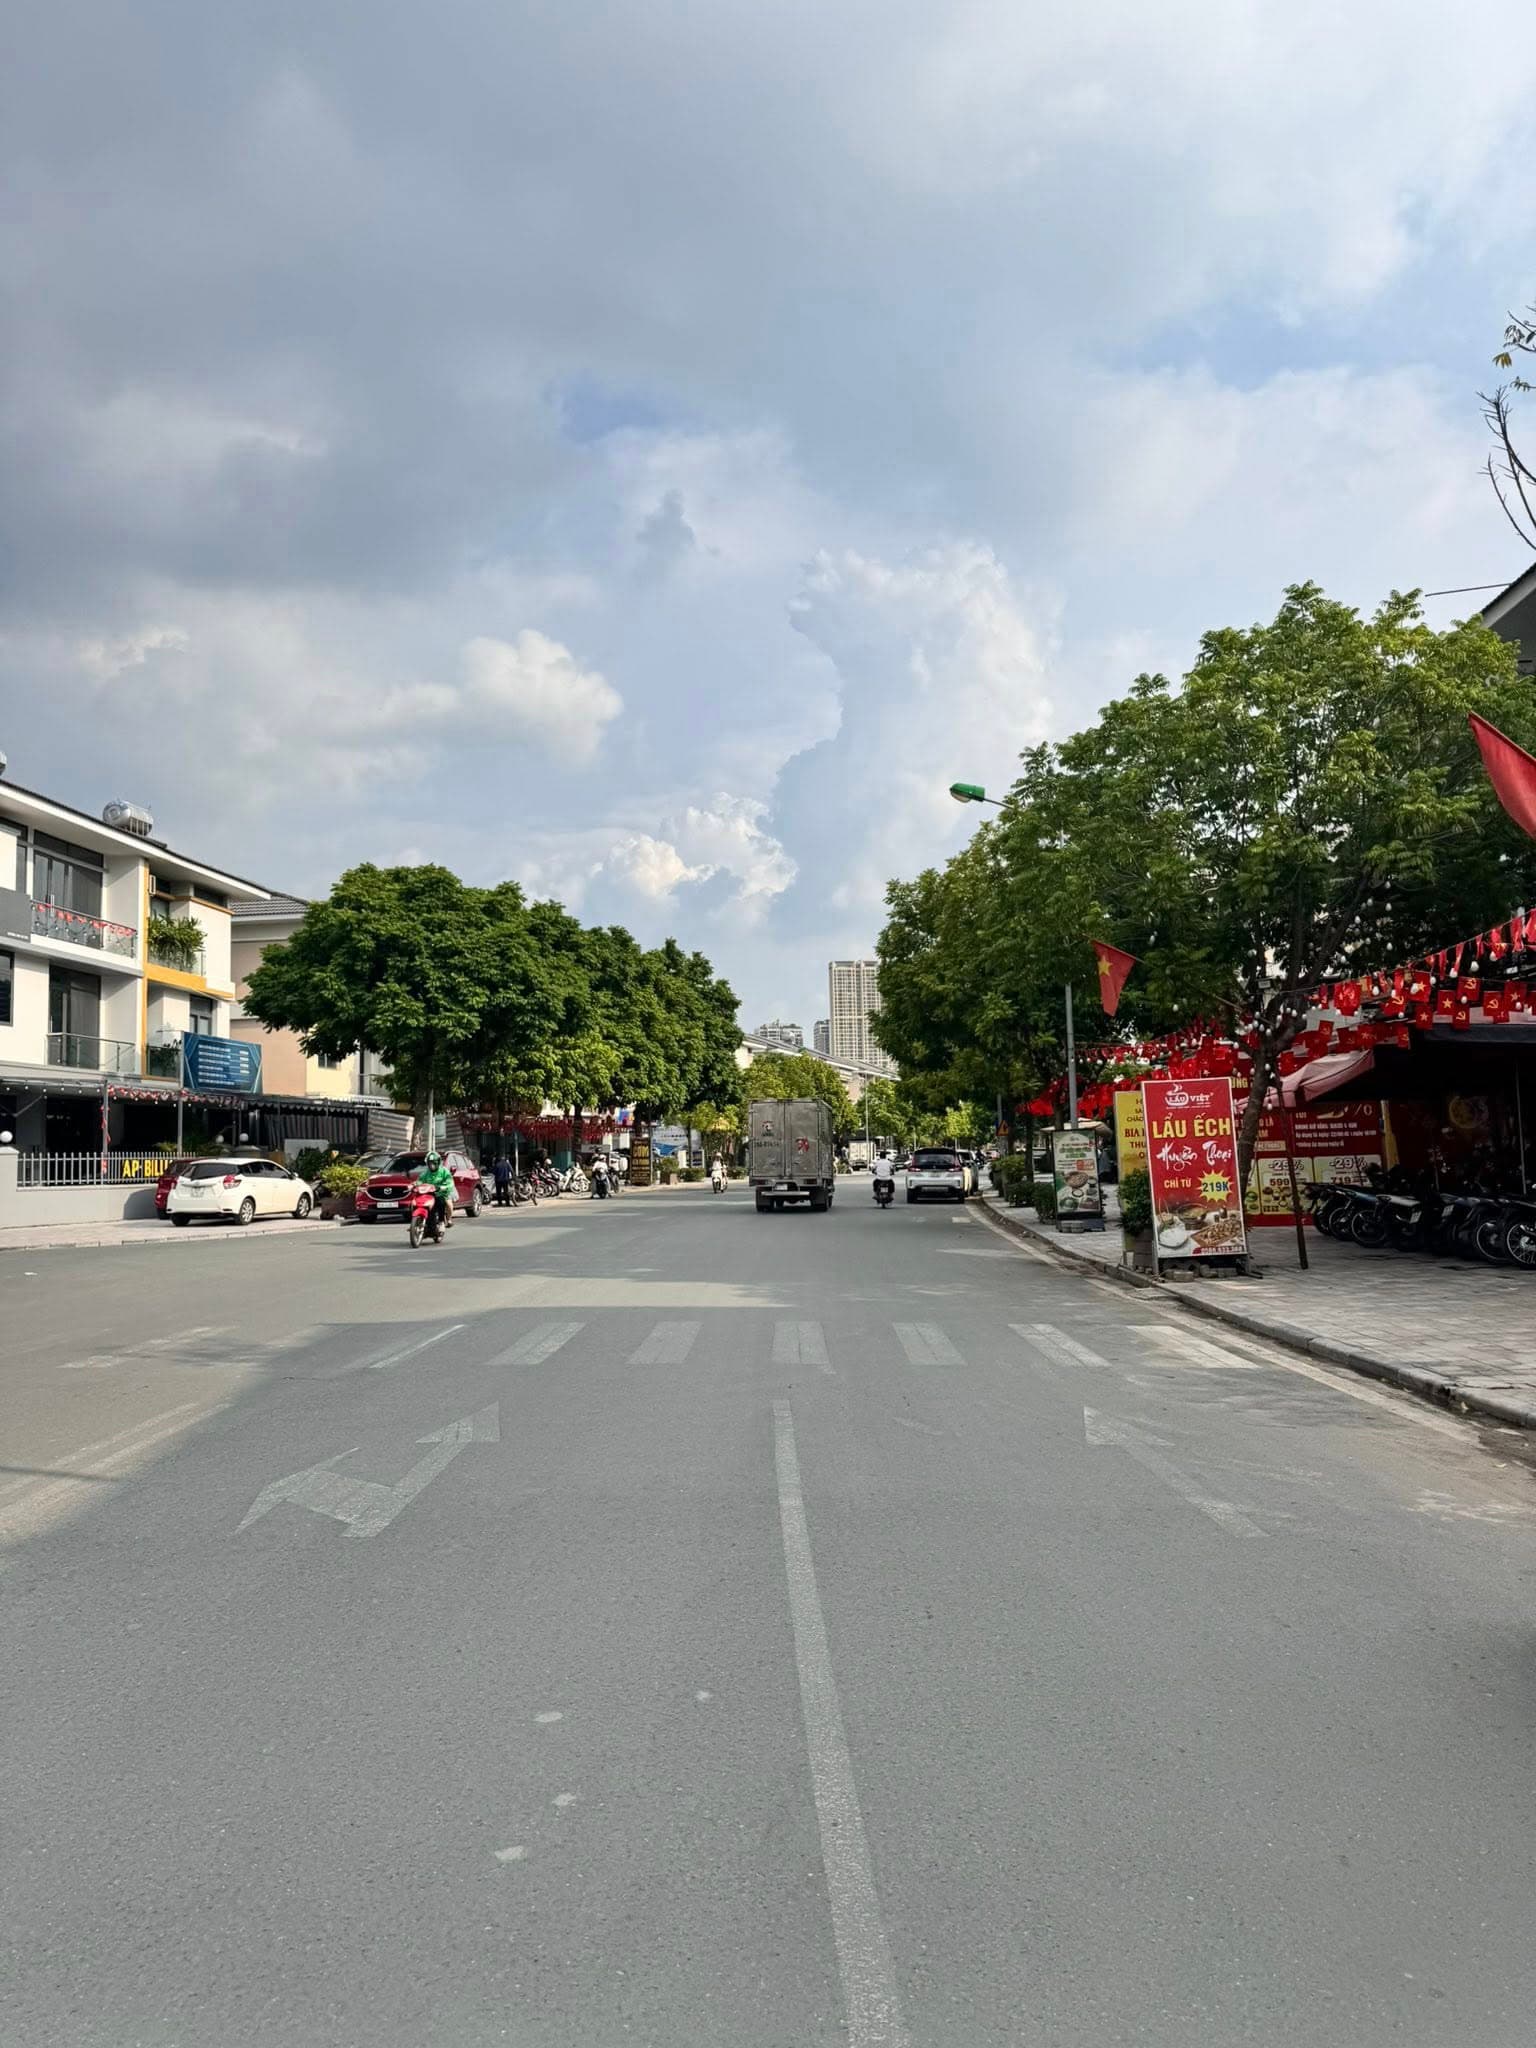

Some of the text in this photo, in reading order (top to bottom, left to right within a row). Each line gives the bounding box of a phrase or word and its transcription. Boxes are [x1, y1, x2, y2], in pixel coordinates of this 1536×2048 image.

[1152, 1112, 1231, 1139] LẨU ẾCH
[1124, 1128, 1140, 1138] BIA
[1156, 1140, 1232, 1171] Huyền Thoại
[1163, 1176, 1179, 1189] CHỈ
[1202, 1182, 1229, 1193] 219K
